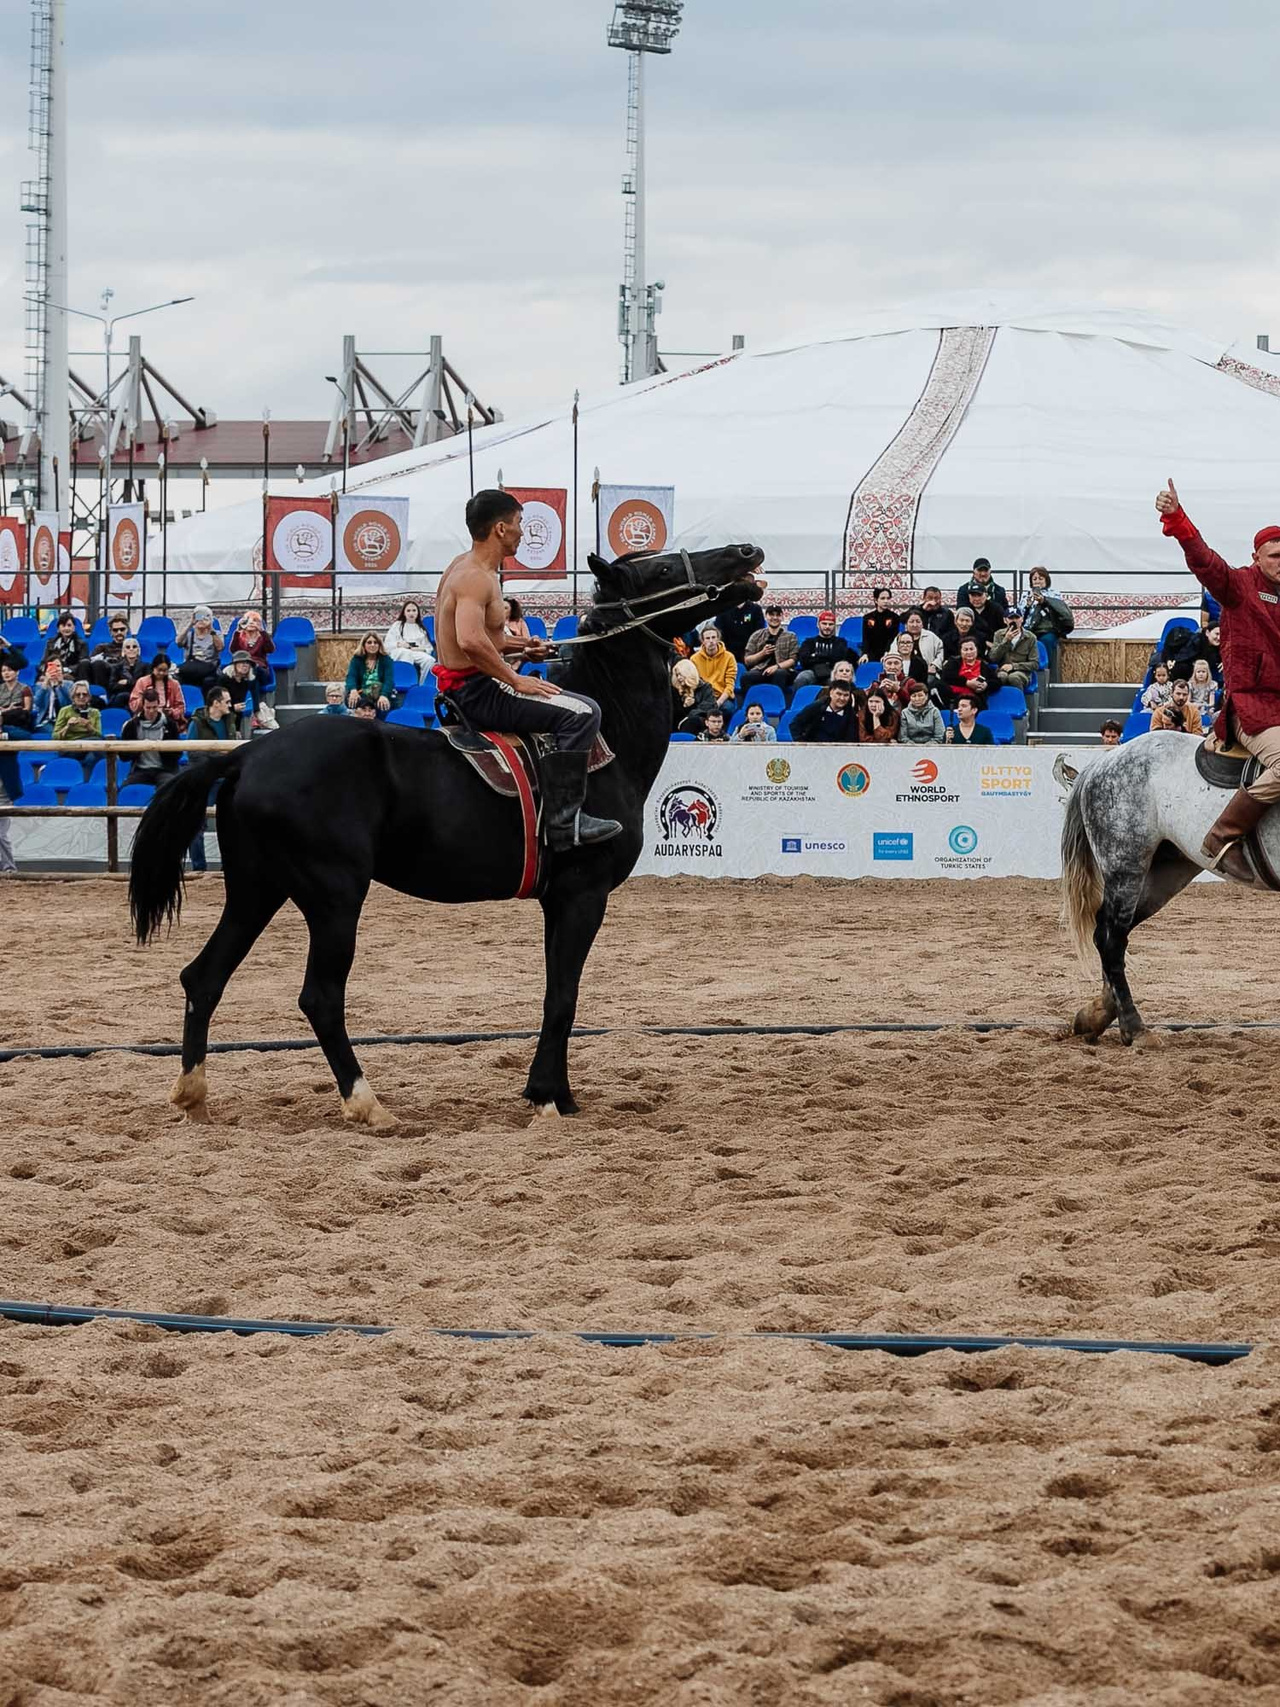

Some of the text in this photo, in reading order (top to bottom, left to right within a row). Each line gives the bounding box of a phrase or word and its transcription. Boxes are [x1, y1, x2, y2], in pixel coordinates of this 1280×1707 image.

[981, 778, 1031, 789] SPORT
[910, 786, 946, 794] WORLD
[896, 795, 960, 803] ETHNOSPORT
[805, 842, 846, 850] unesco
[878, 838, 899, 846] unicef
[654, 844, 723, 857] AUDARYSPAQ
